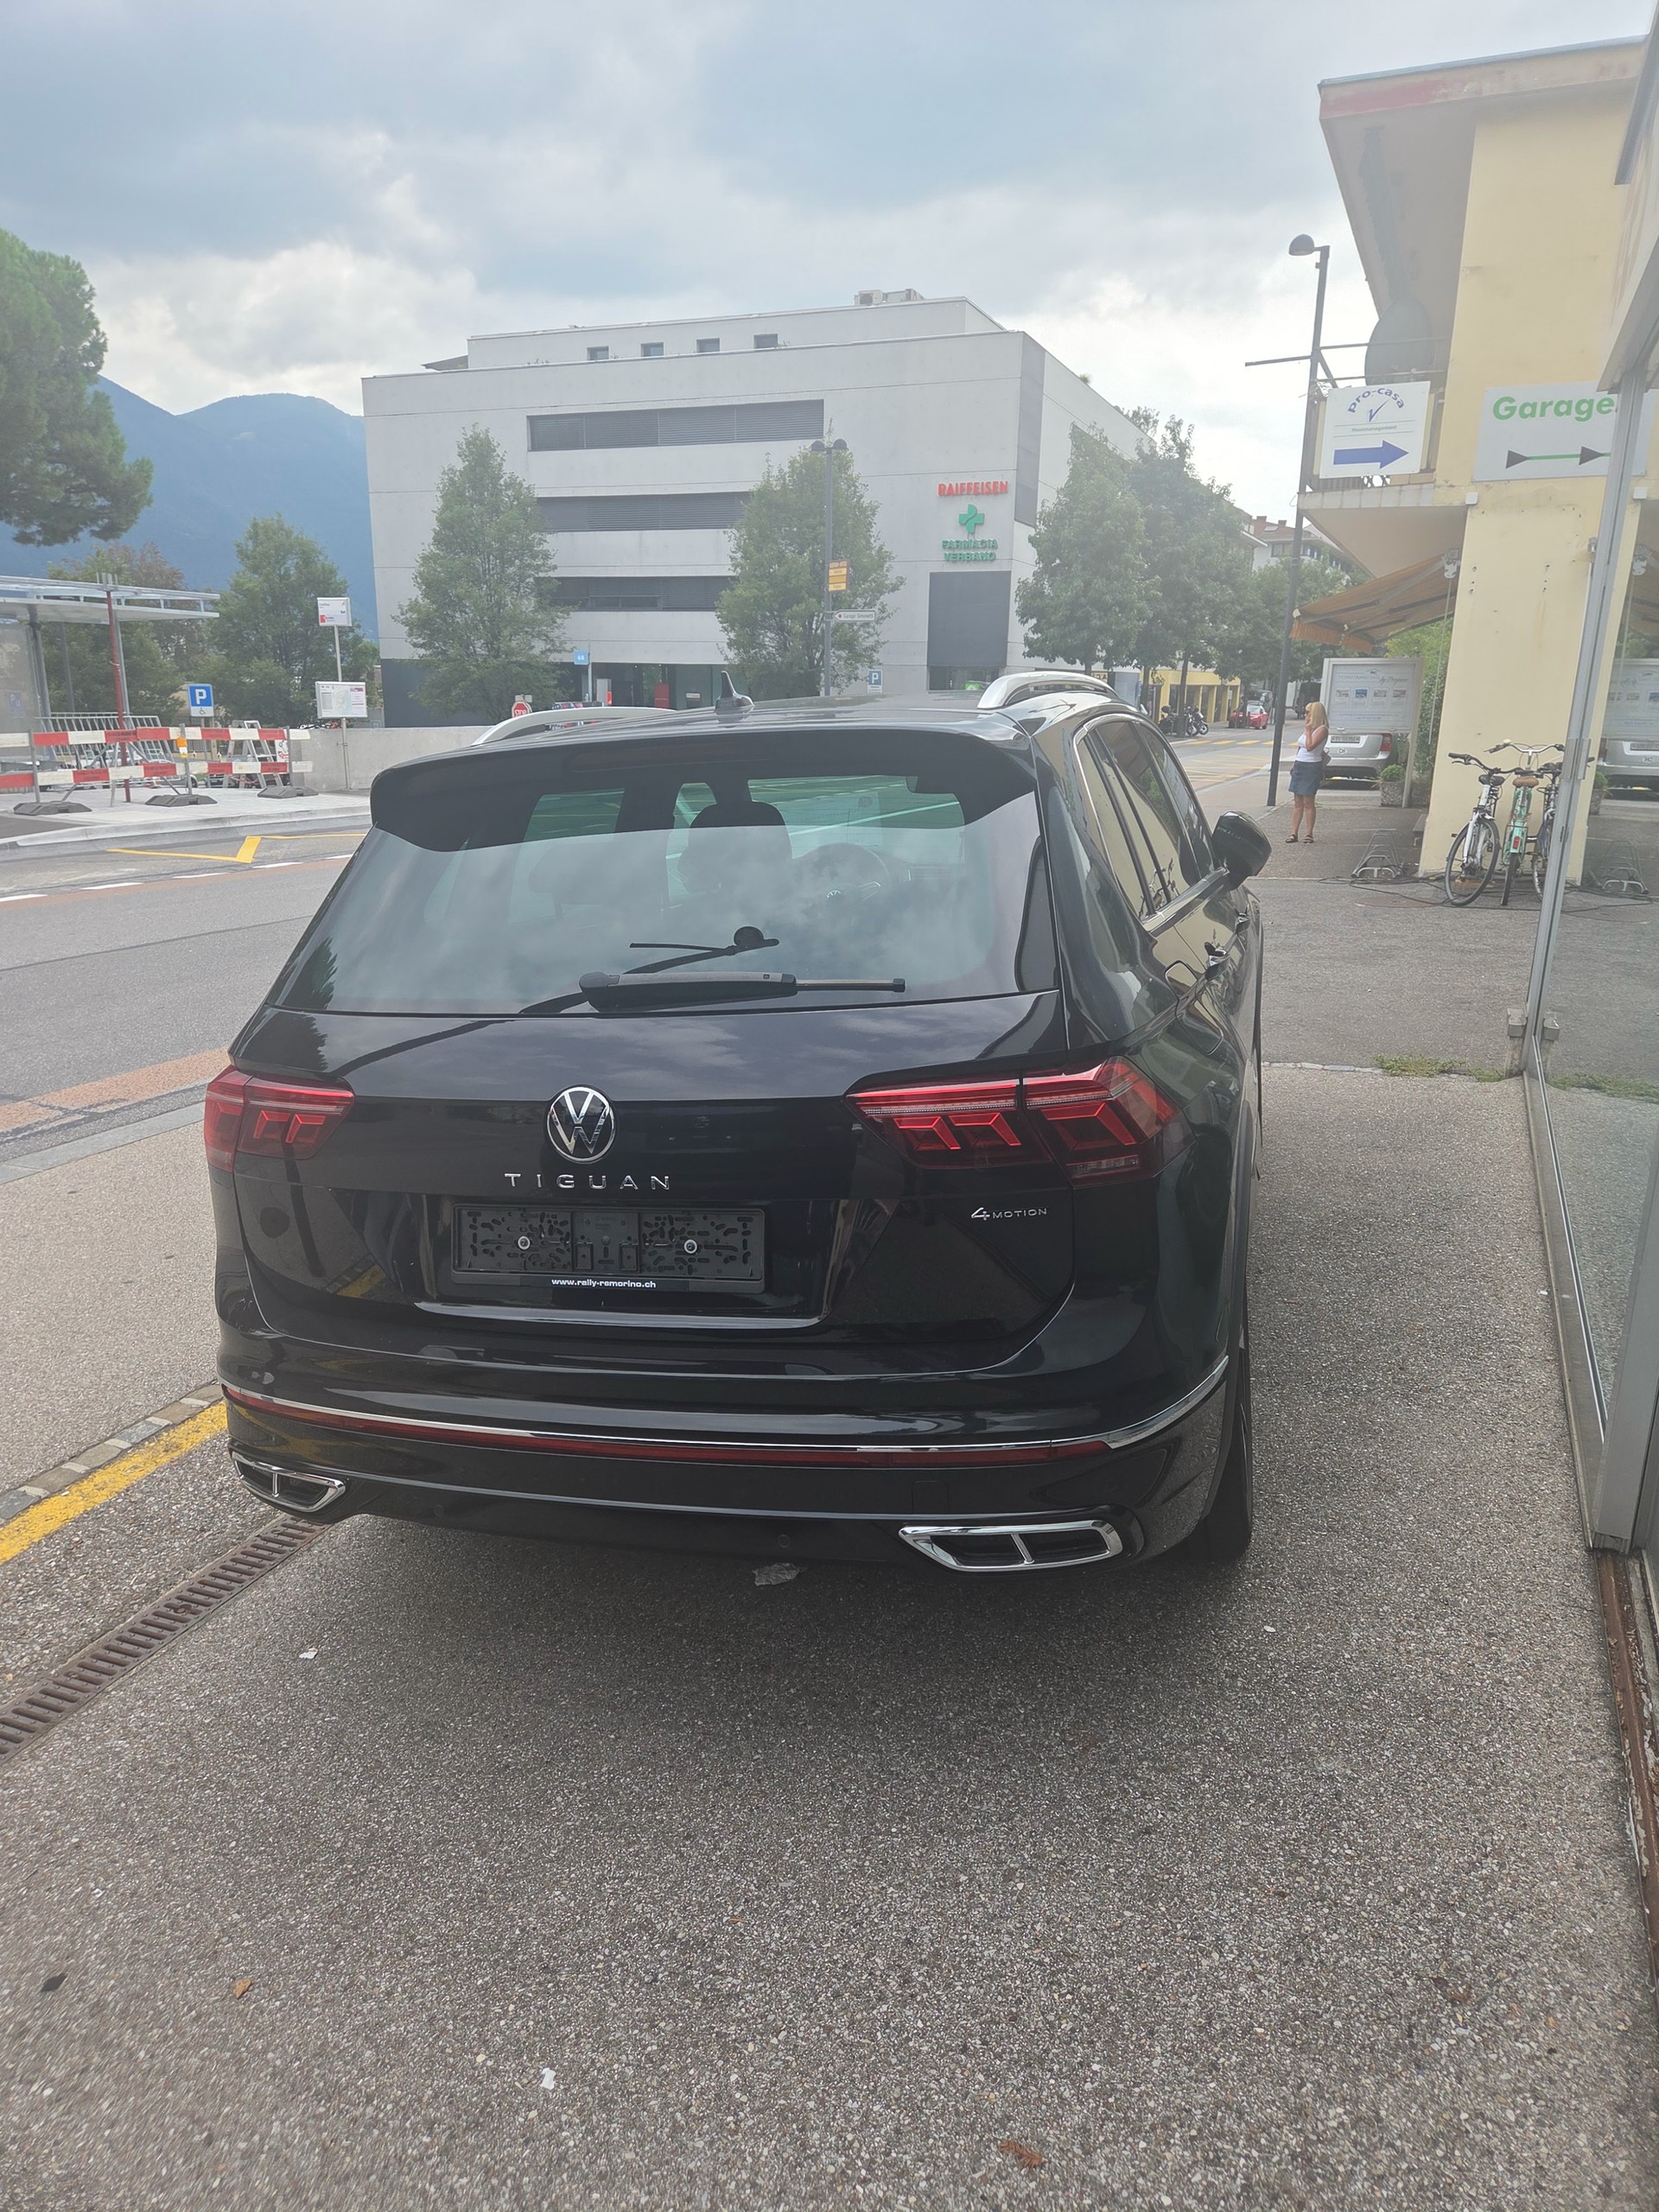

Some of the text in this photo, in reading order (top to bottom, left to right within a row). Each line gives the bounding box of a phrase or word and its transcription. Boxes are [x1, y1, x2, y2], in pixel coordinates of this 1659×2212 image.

[1348, 388, 1404, 413] pro-casa
[1492, 396, 1615, 422] Garage
[938, 480, 1008, 496] RAIFFEISEN
[941, 539, 998, 550] FARMACIA
[944, 551, 996, 563] VERBANO
[872, 672, 879, 684] P
[195, 689, 207, 704] P
[505, 1173, 670, 1190] TIGUAN
[971, 1207, 1047, 1220] 4MOTION
[551, 1279, 657, 1287] www.rally-remorino.ch
